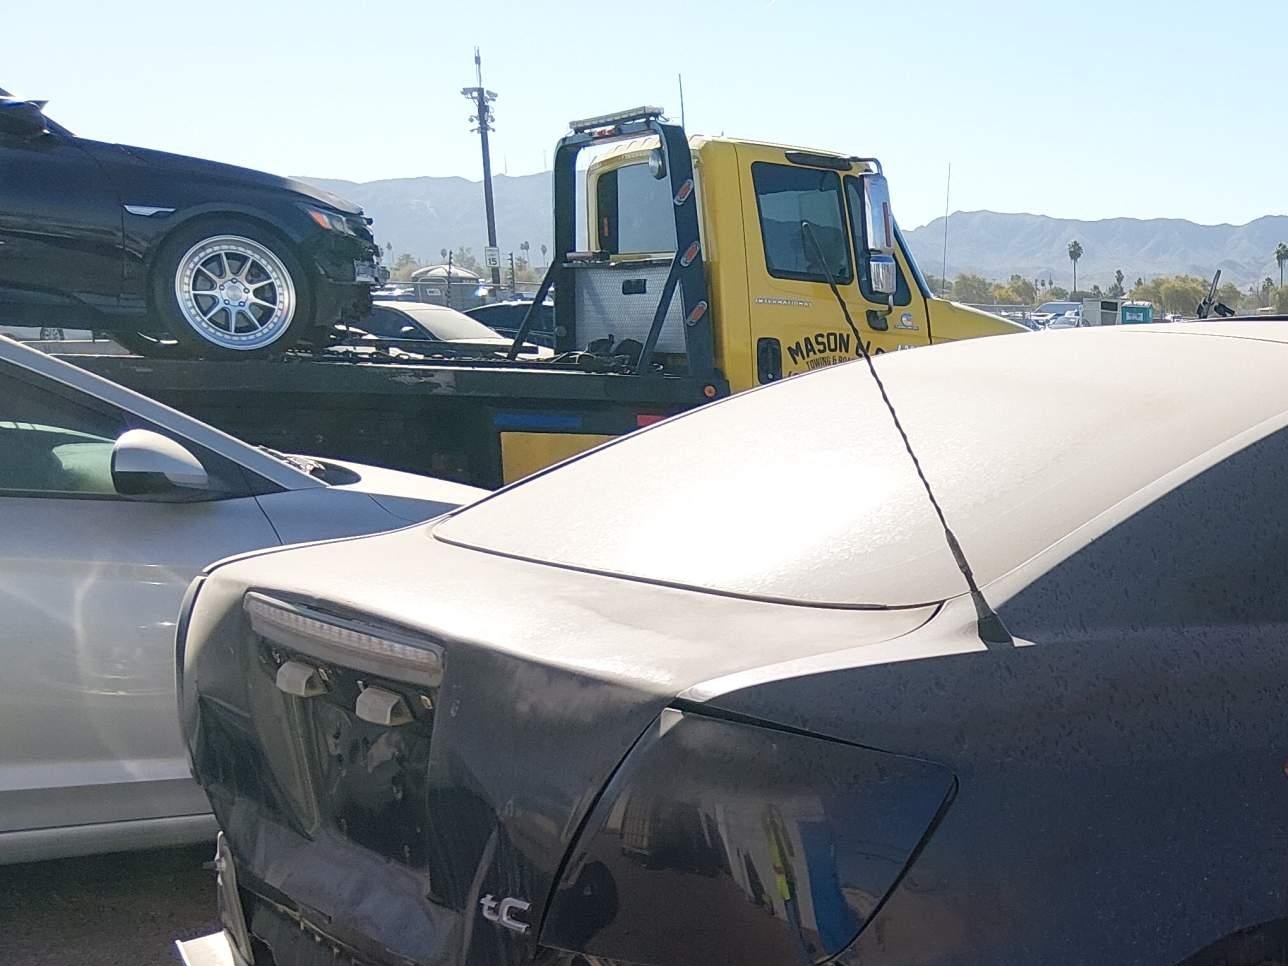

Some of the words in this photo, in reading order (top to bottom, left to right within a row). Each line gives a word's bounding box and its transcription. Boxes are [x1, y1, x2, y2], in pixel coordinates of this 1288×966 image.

[488, 257, 497, 265] 15
[787, 332, 850, 365] MASON
[806, 356, 830, 370] TOWING
